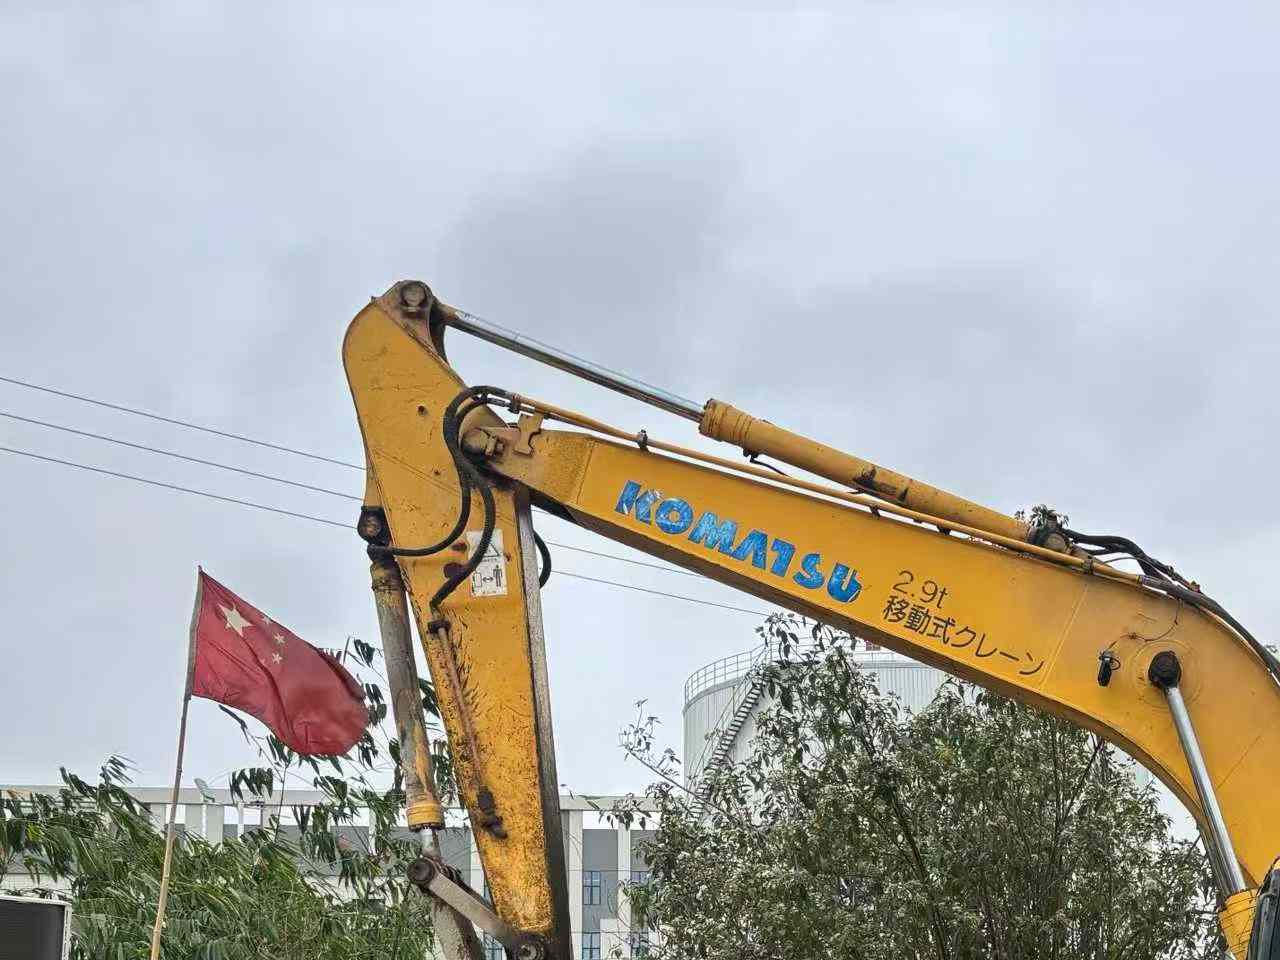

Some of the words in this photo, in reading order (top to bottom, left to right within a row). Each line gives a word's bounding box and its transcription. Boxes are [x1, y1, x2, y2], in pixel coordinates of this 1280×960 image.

[615, 480, 864, 603] KOMATSU
[891, 569, 950, 611] 2.9t
[883, 595, 1046, 676] 移動式クレーン
